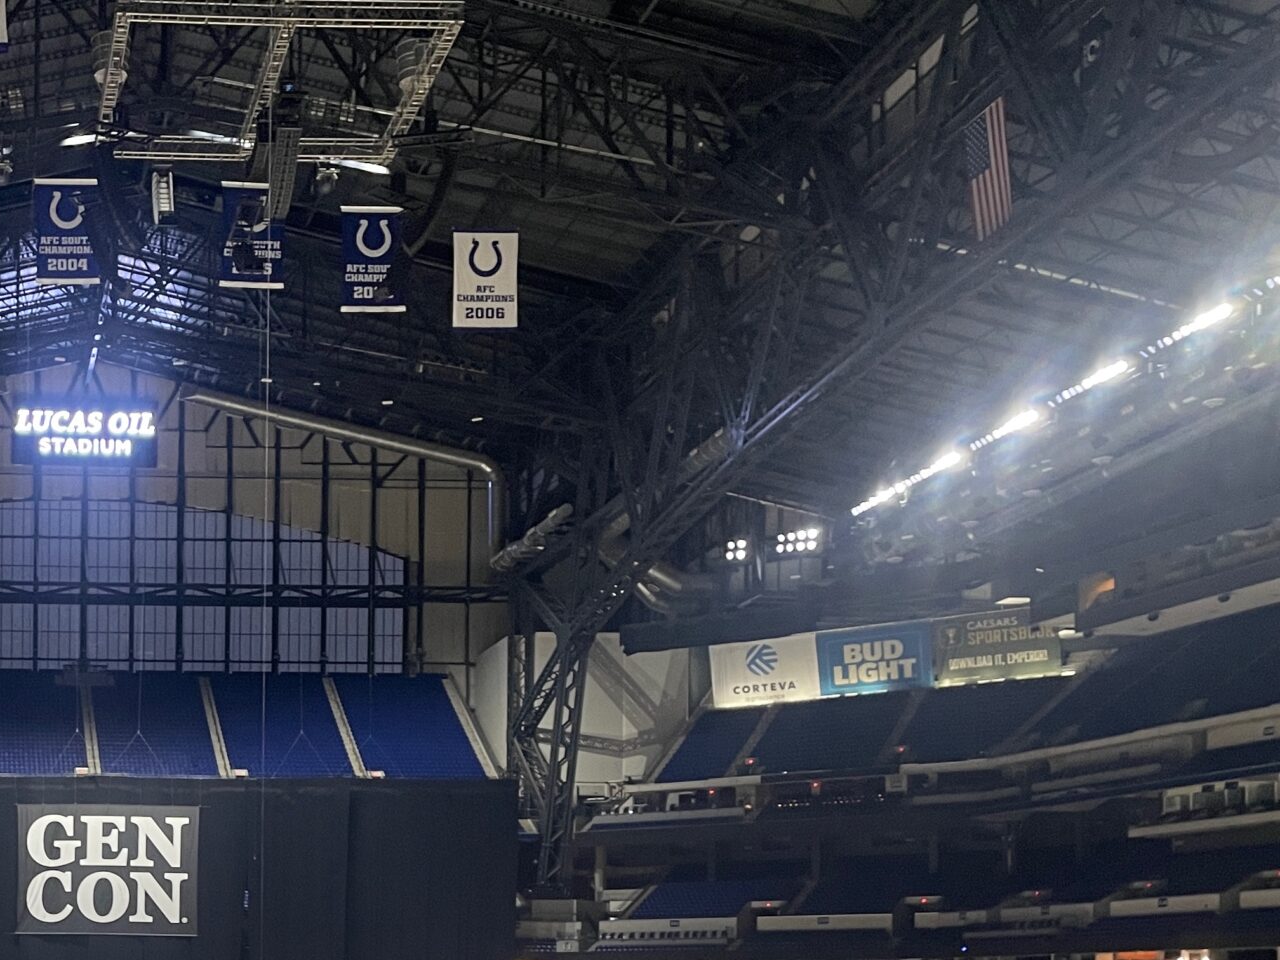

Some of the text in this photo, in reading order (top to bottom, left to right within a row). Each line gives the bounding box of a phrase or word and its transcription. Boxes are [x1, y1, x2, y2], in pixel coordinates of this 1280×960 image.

[40, 236, 90, 245] AFC SOUT
[39, 245, 93, 254] CHAMPION
[47, 258, 88, 271] 2004
[346, 264, 391, 273] AFC SOU
[476, 285, 495, 293] AFC
[457, 294, 515, 302] CHAMPIONS
[465, 307, 505, 319] 2006
[14, 408, 156, 437] LUCAS OIL
[38, 436, 132, 456] STADIUM
[966, 616, 1018, 630] CAESARS
[843, 639, 904, 664] BUD
[833, 658, 917, 686] LIGHT
[733, 680, 797, 695] CORTEVA
[26, 814, 190, 868] GEN
